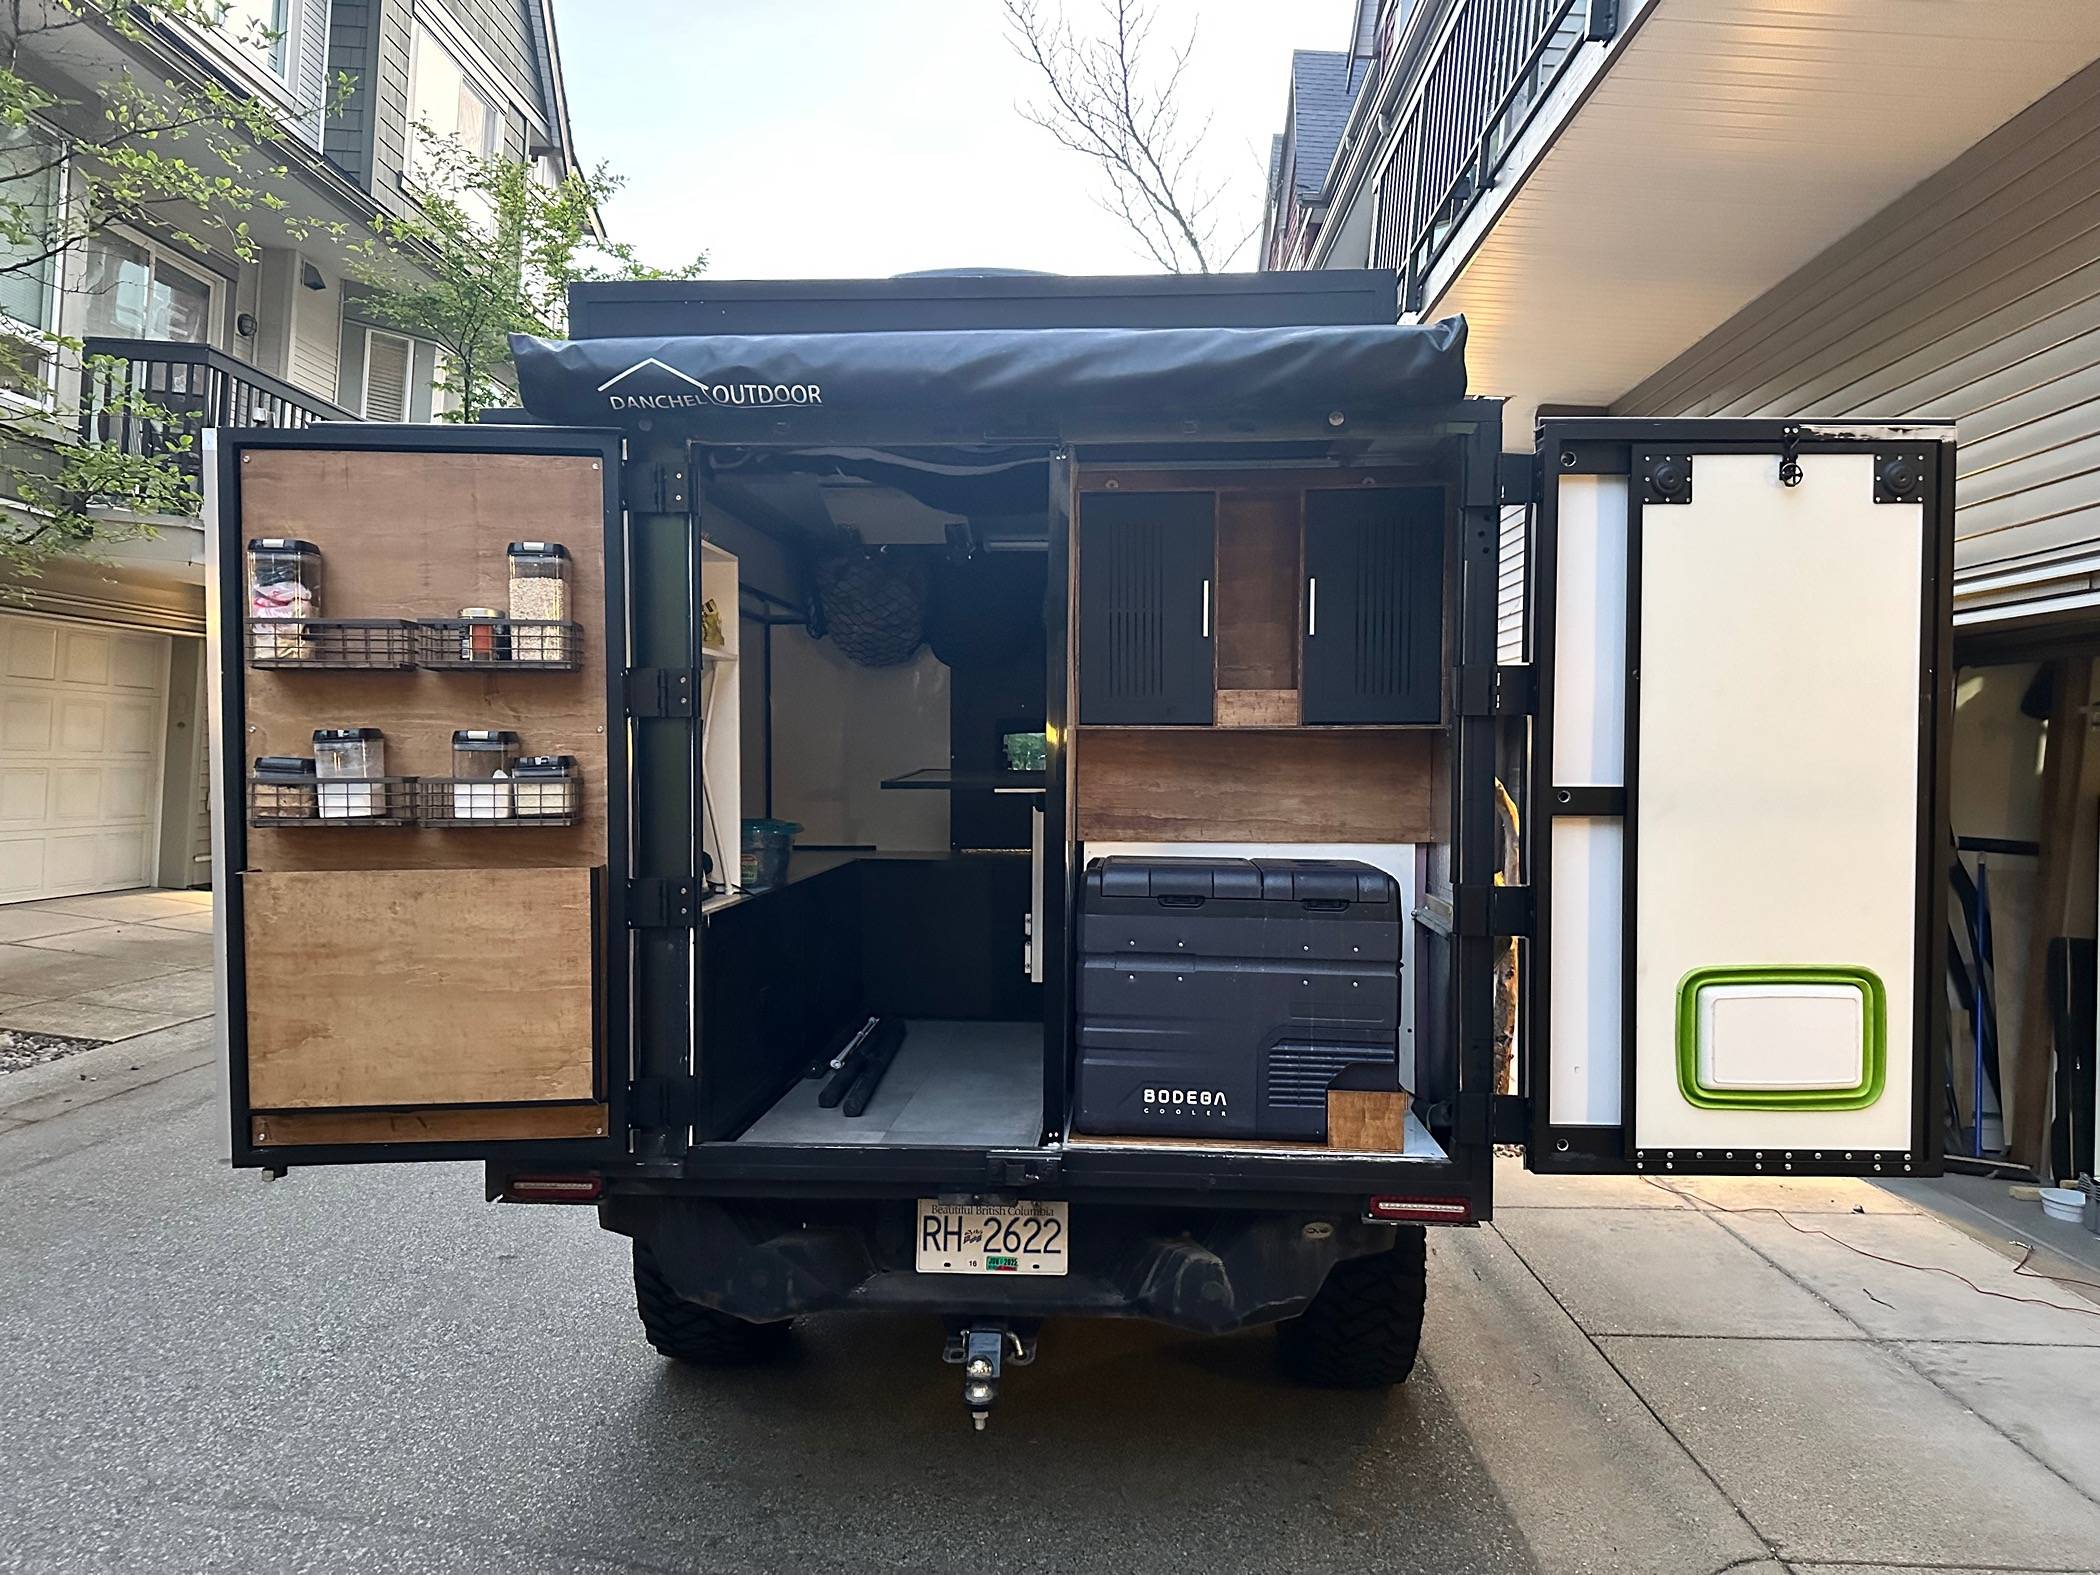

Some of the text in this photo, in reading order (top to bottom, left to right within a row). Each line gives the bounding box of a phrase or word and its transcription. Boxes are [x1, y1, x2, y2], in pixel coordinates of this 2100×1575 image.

[610, 384, 823, 410] DANCHEL OUTDOOR
[1143, 1088, 1227, 1106] BODEGA
[1143, 1107, 1227, 1117] COOLER
[931, 1204, 1055, 1217] Beautiful British Columbia
